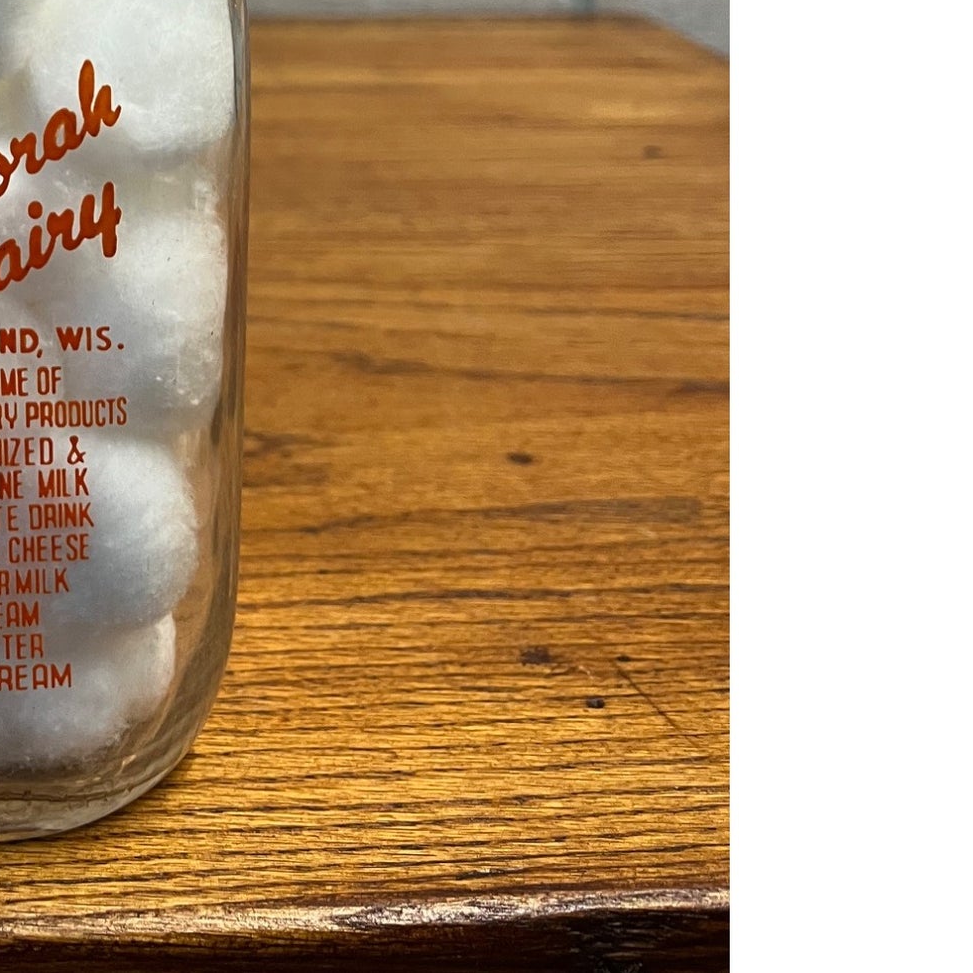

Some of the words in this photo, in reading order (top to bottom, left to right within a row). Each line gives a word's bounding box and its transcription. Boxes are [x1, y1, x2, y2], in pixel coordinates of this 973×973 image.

[56, 326, 124, 351] WIS.
[37, 366, 61, 395] OF
[26, 397, 127, 428] PRODUCTS
[67, 435, 86, 464] &
[38, 468, 90, 498] MILK
[29, 502, 94, 530] DRINK
[9, 534, 90, 564] CHEESE
